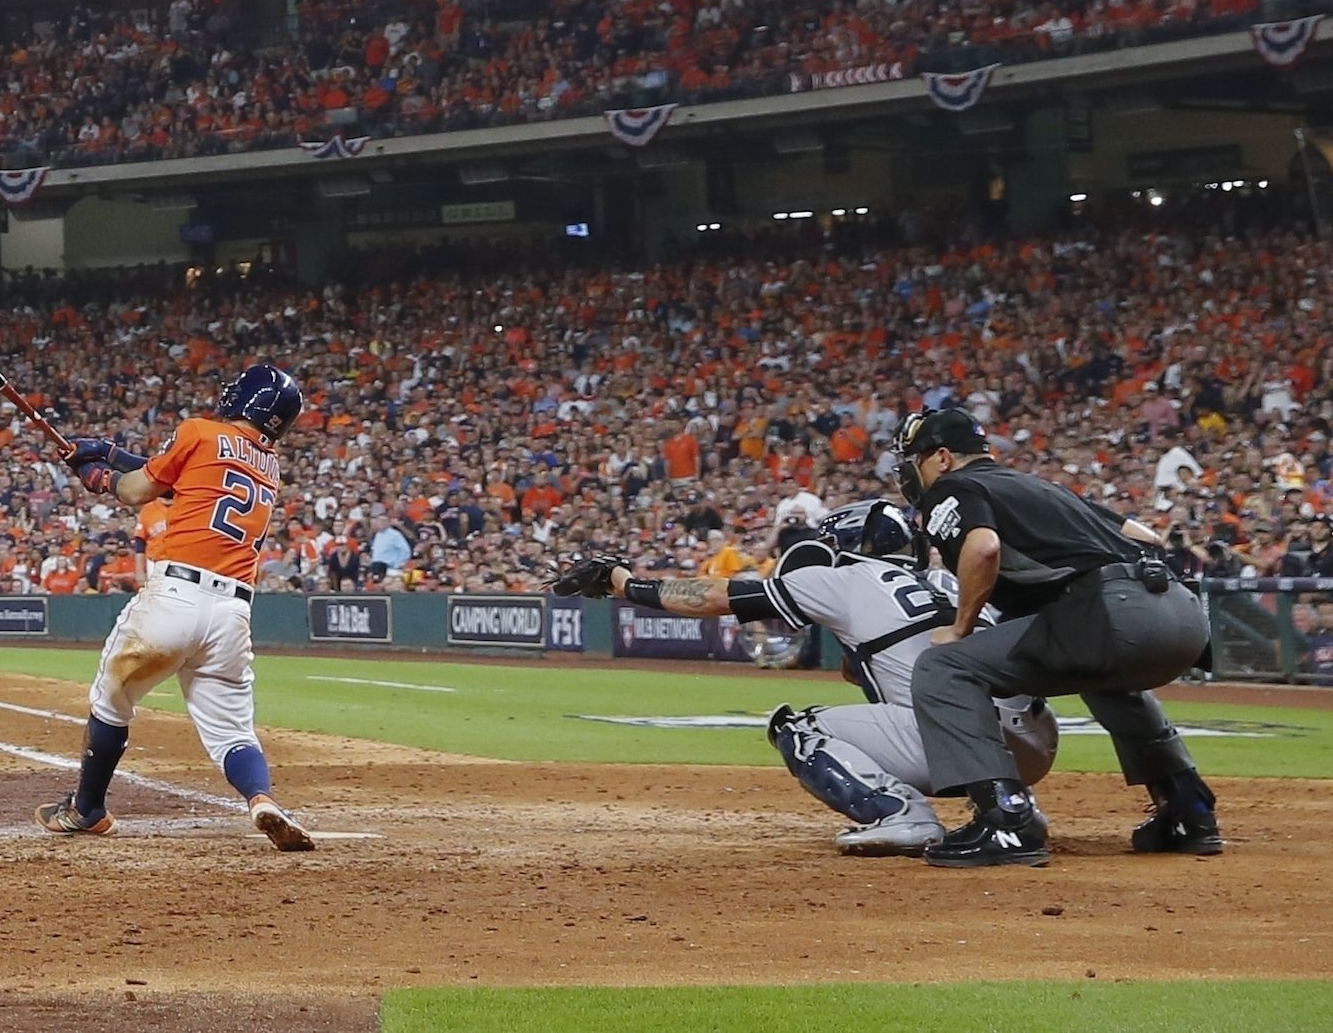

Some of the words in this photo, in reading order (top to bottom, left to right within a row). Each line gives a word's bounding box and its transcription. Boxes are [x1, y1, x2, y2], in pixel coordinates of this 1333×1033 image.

[217, 434, 281, 487] ALTUV
[451, 605, 500, 634] CAMPING
[500, 606, 541, 636] WORLD
[551, 608, 583, 645] FS1
[657, 617, 702, 640] NETWORK
[996, 830, 1022, 849] N
